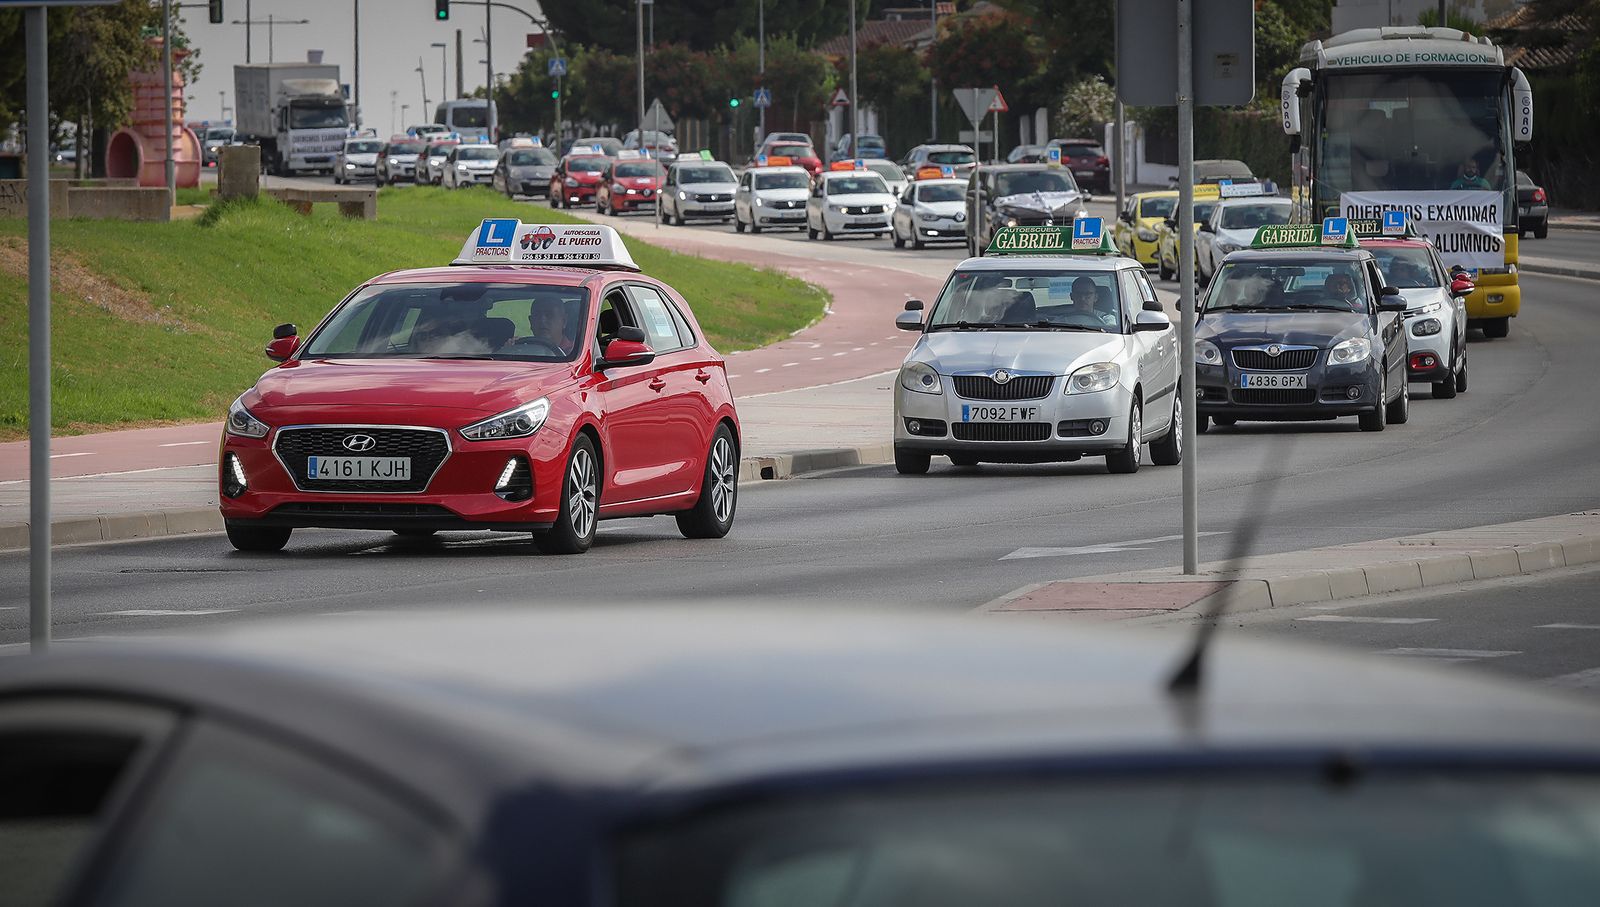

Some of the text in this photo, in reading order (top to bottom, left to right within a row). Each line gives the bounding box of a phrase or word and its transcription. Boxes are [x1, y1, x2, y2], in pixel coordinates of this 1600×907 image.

[1336, 52, 1488, 65] VEHICULO DE FORMACION
[1389, 214, 1399, 225] L
[1428, 204, 1496, 223] EXAMINAR
[486, 223, 504, 243] L
[1079, 220, 1093, 236] L
[1328, 221, 1340, 233] L
[558, 238, 602, 246] EL PUERTO
[996, 232, 1064, 250] GABRIEL
[1261, 229, 1317, 245] GABRIEL
[1435, 233, 1501, 253] ALUMNOS
[475, 247, 510, 256] PRACTICAS
[1249, 375, 1303, 387] 4836 GPX
[971, 407, 1037, 420] 7092 FWF
[319, 459, 405, 477] 4161 KJH
